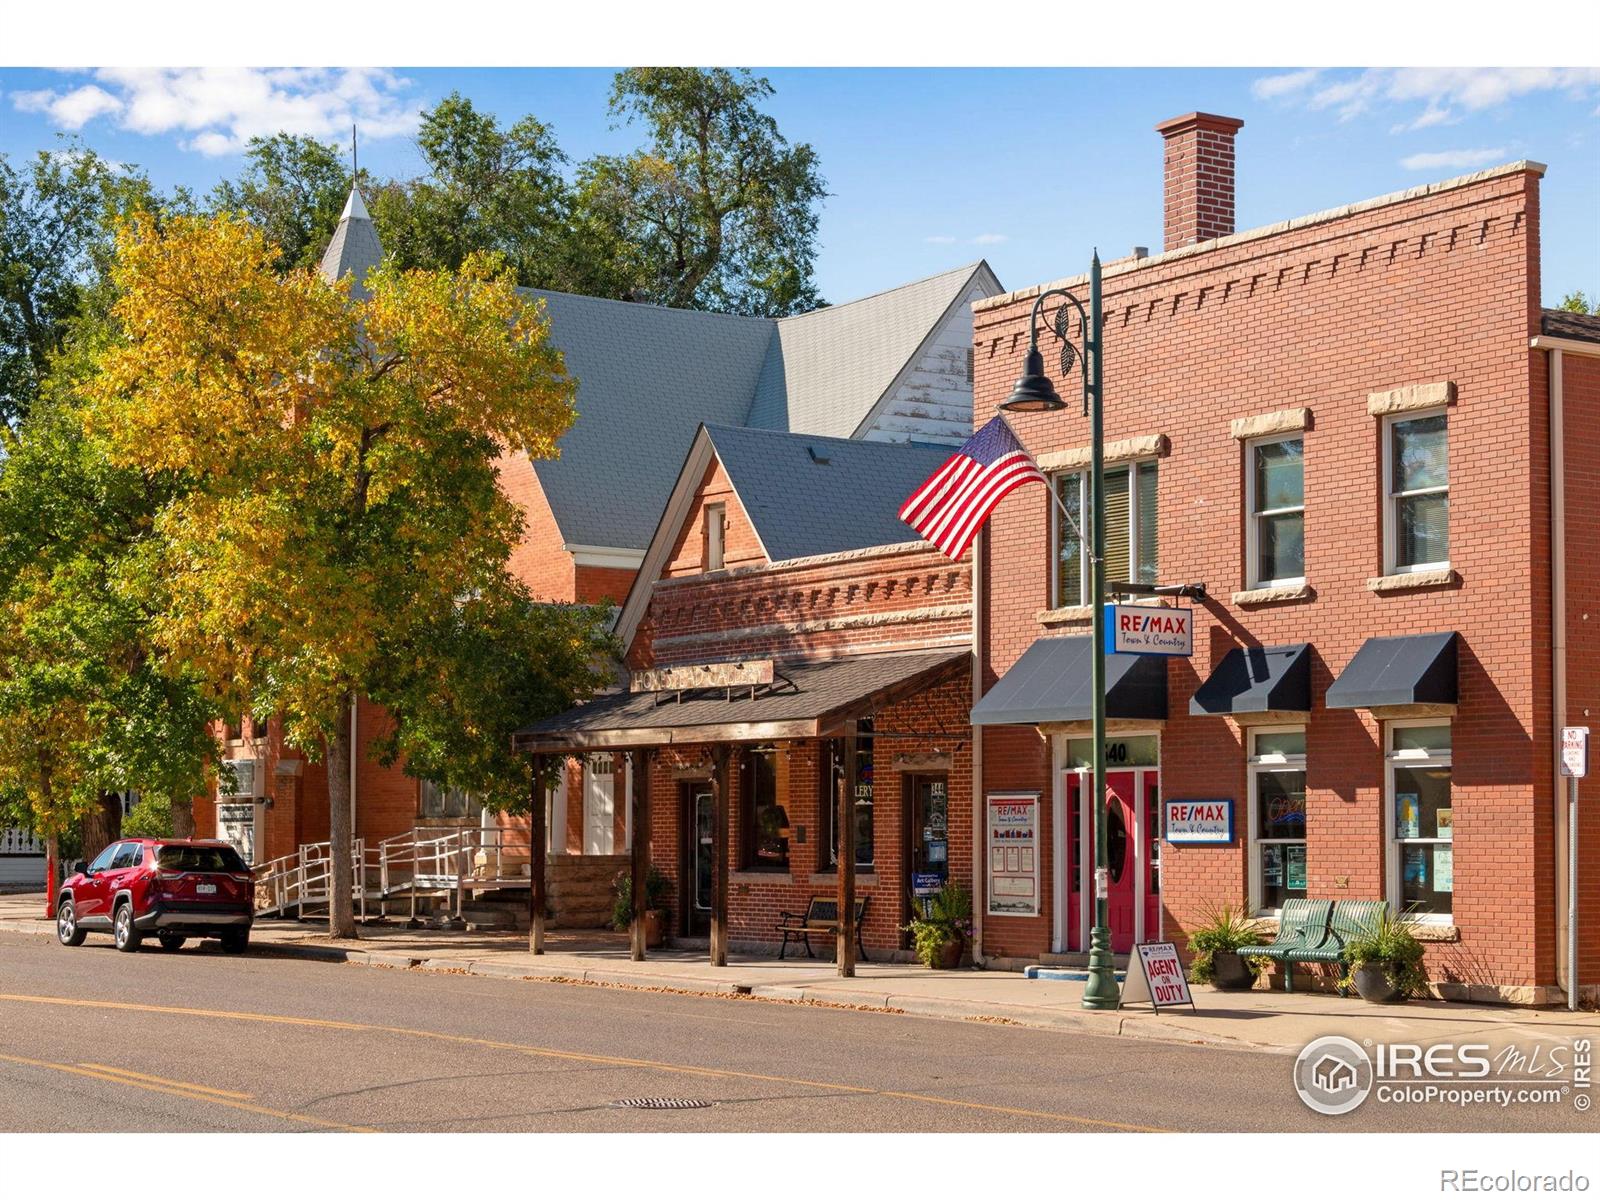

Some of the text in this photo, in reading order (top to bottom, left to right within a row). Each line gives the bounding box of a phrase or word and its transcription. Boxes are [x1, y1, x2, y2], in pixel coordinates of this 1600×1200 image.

[1121, 615, 1185, 634] RE/MAX
[1122, 632, 1185, 650] Town & Country
[997, 806, 1028, 816] RE/MAX
[1171, 805, 1224, 821] RE/MAX
[1172, 823, 1188, 833] Town
[1197, 823, 1224, 839] Country
[1148, 959, 1179, 981] AGENT
[1162, 975, 1171, 984] ON
[1155, 984, 1184, 1002] DUTY
